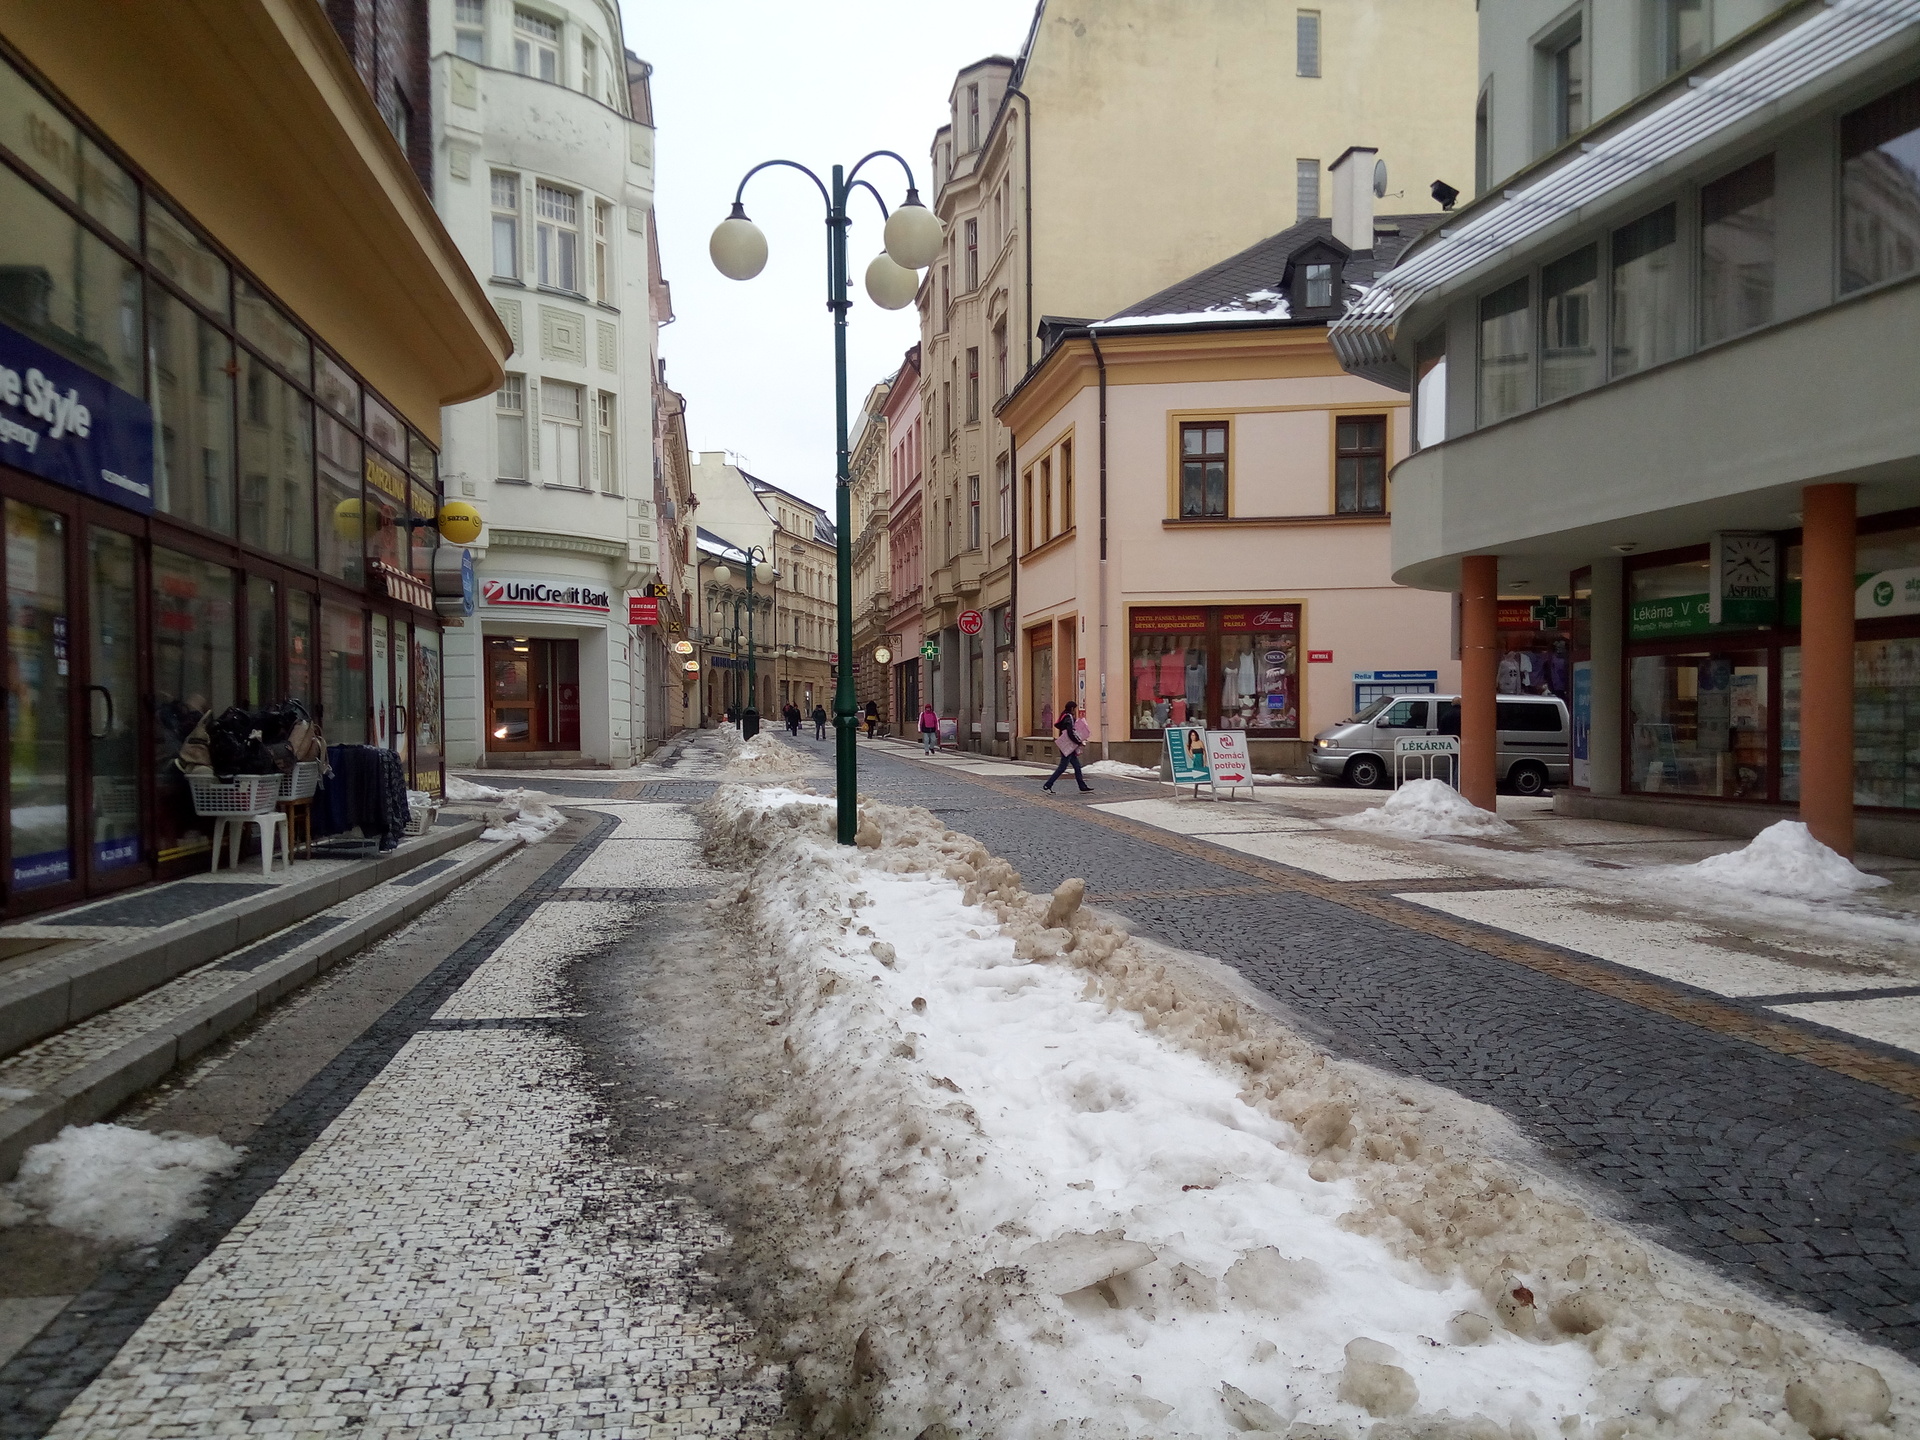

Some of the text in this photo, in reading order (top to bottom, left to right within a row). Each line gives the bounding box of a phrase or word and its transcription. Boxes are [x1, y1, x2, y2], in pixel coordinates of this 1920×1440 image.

[23, 367, 91, 439] Style
[507, 583, 609, 607] UniCredit Bank
[1726, 584, 1769, 598] ASPIRIN
[1633, 603, 1674, 621] Lékárna
[1681, 602, 1690, 616] V
[1402, 740, 1453, 751] LÉKÁRNA
[1214, 761, 1246, 770] potřeby
